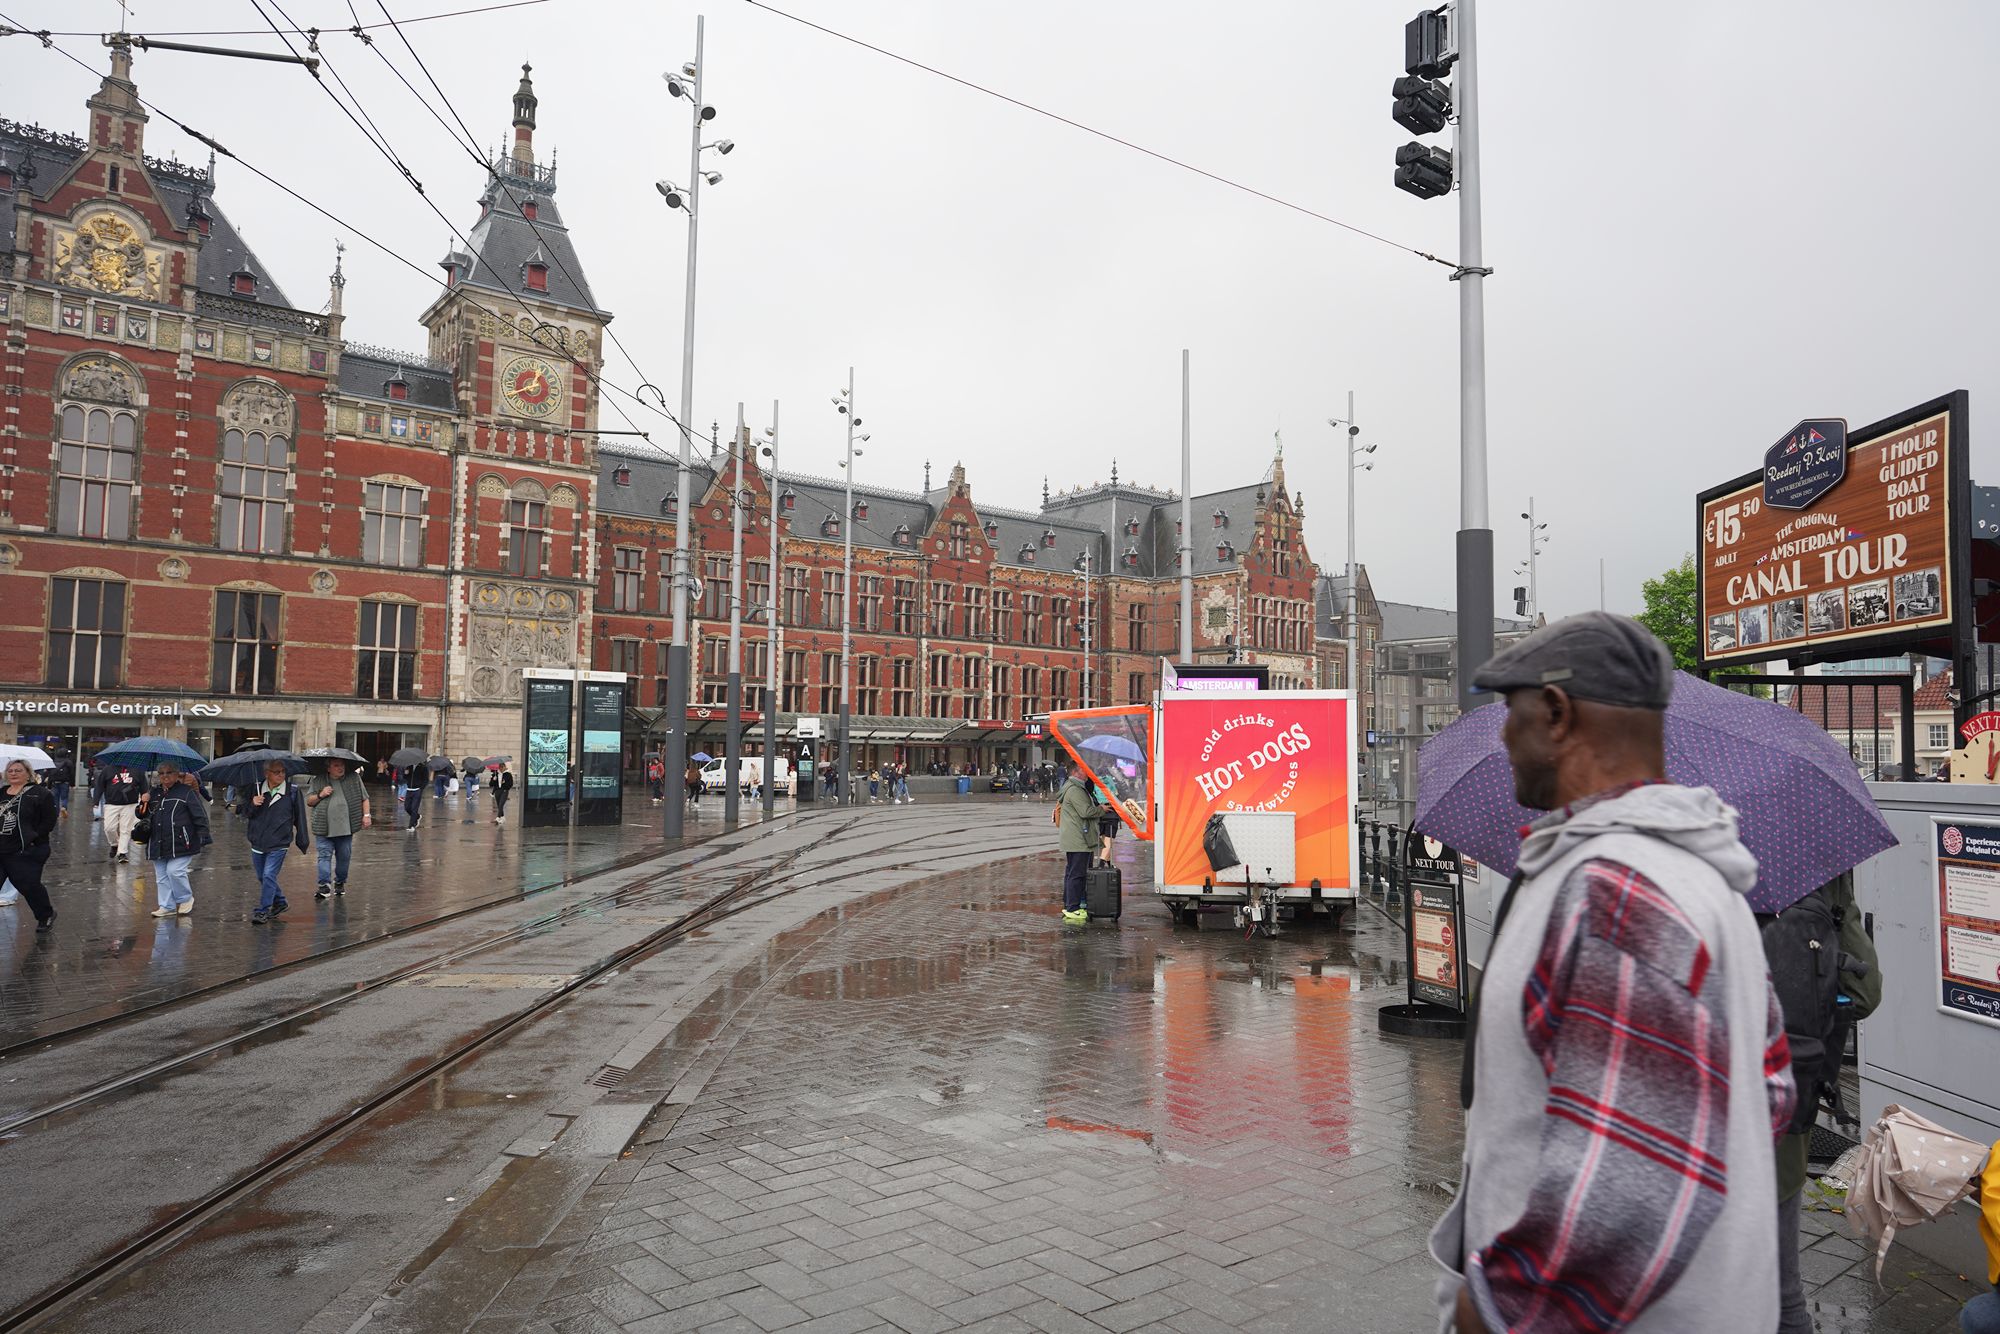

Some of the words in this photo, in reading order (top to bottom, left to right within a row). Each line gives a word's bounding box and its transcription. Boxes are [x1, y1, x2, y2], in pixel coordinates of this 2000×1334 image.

[1803, 451, 1814, 471] P.
[1815, 445, 1841, 465] Kooij
[1881, 447, 1887, 464] 1
[1890, 429, 1938, 461] HOUR
[1879, 450, 1939, 483] GUIDED
[1887, 473, 1929, 501] BOAT
[1886, 494, 1930, 521] TOUR
[1775, 521, 1794, 543] THE
[1795, 513, 1838, 530] ORIGINAL
[1770, 526, 1845, 562] AMSTERDAM
[1714, 551, 1738, 568] ADULT
[1726, 559, 1808, 606] CANAL
[1819, 533, 1907, 584] TOUR
[1182, 681, 1243, 691] AMSTERDAM
[1246, 681, 1256, 691] IN
[0, 698, 90, 714] sterdam
[97, 700, 179, 716] Centraal
[1030, 724, 1041, 734] M
[1201, 729, 1223, 762] cold
[1223, 713, 1275, 732] drinks
[1962, 715, 1991, 741] NEXT
[801, 744, 811, 756] A
[1195, 760, 1245, 802] HOT
[1247, 722, 1311, 770] DOGS
[1226, 761, 1299, 813] sandwiches
[1965, 837, 2000, 848] Experience
[1965, 845, 1991, 855] Original
[1415, 857, 1434, 869] NEXT
[1435, 860, 1455, 871] TOUR
